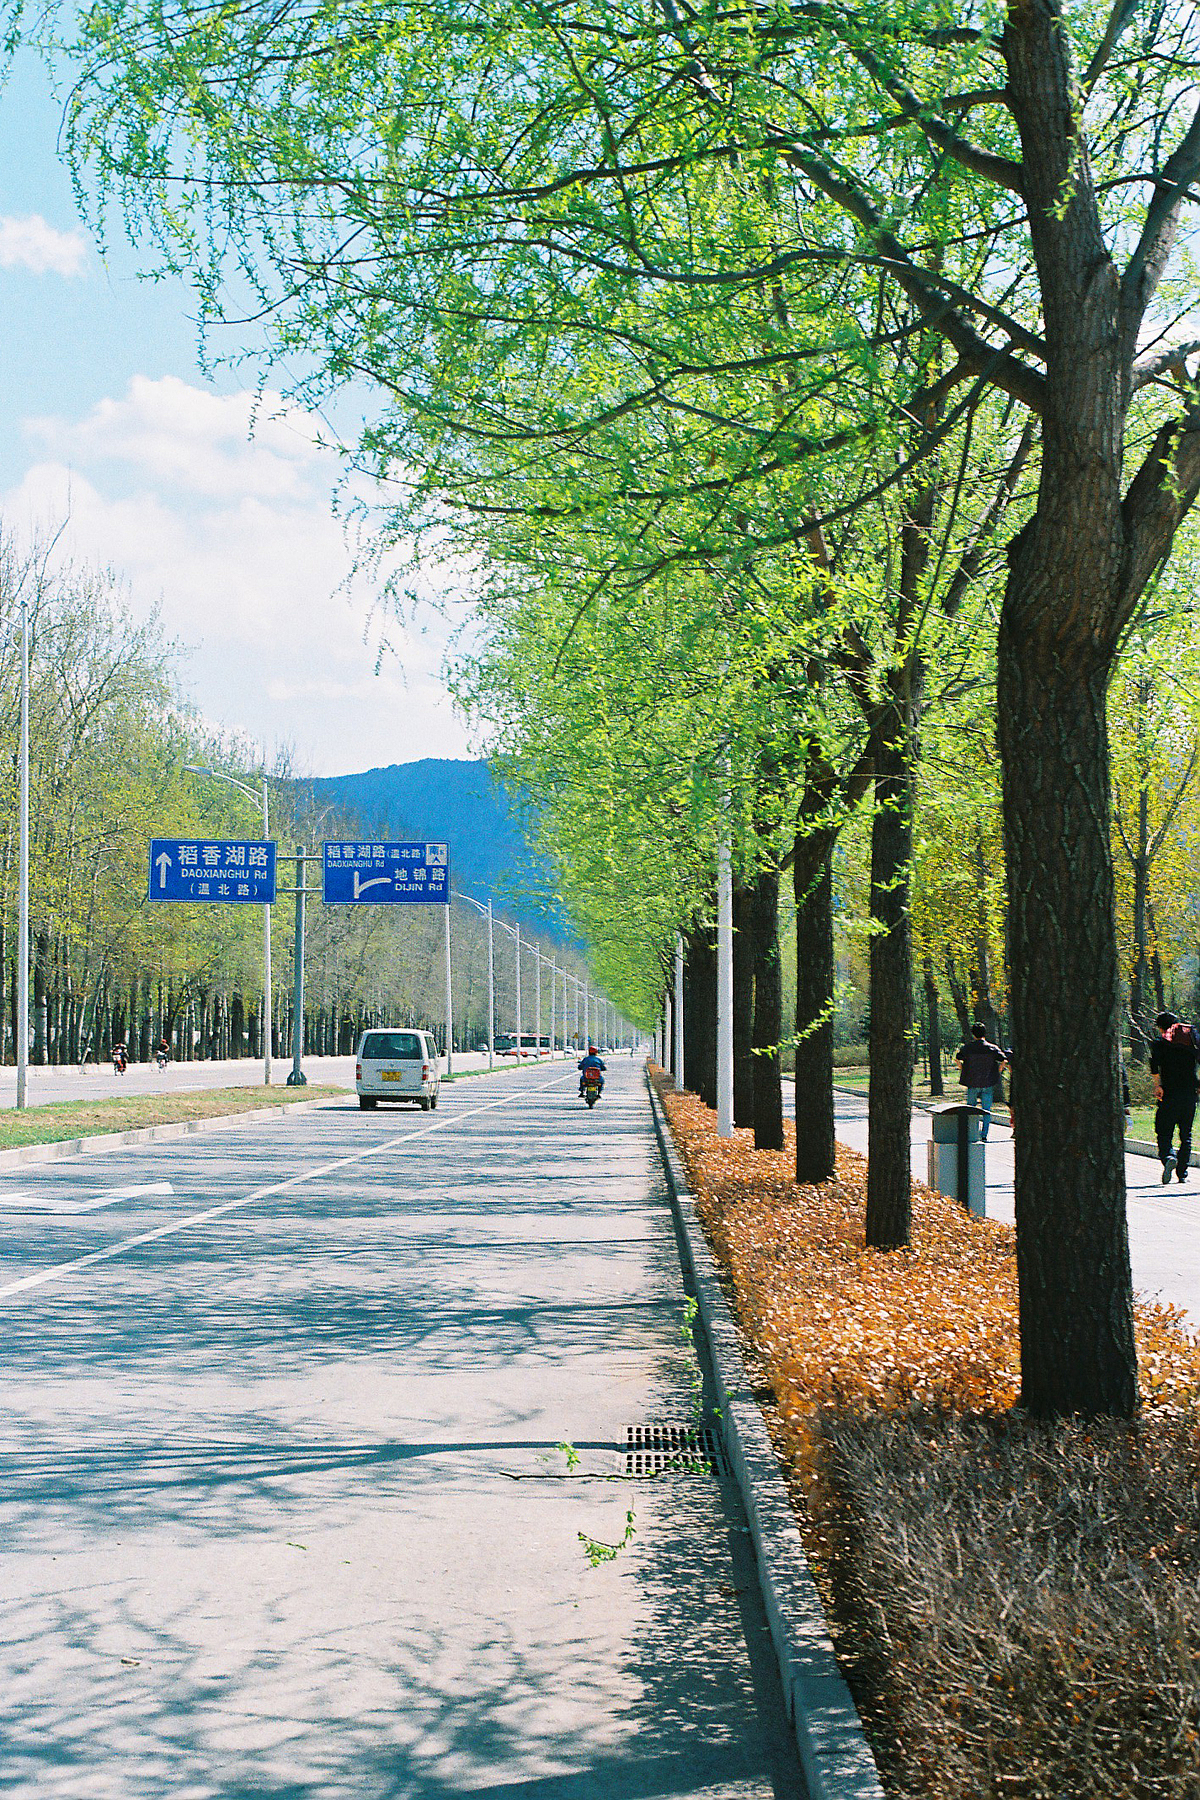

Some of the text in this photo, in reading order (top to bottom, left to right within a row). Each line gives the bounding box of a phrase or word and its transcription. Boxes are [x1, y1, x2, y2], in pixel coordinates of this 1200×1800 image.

[178, 845, 269, 866] 稻香湖路
[327, 859, 385, 868] DAOXIANGHU Rd
[181, 868, 267, 880] DAOXIANGHU Rd
[395, 883, 443, 891] DIJIN Rd
